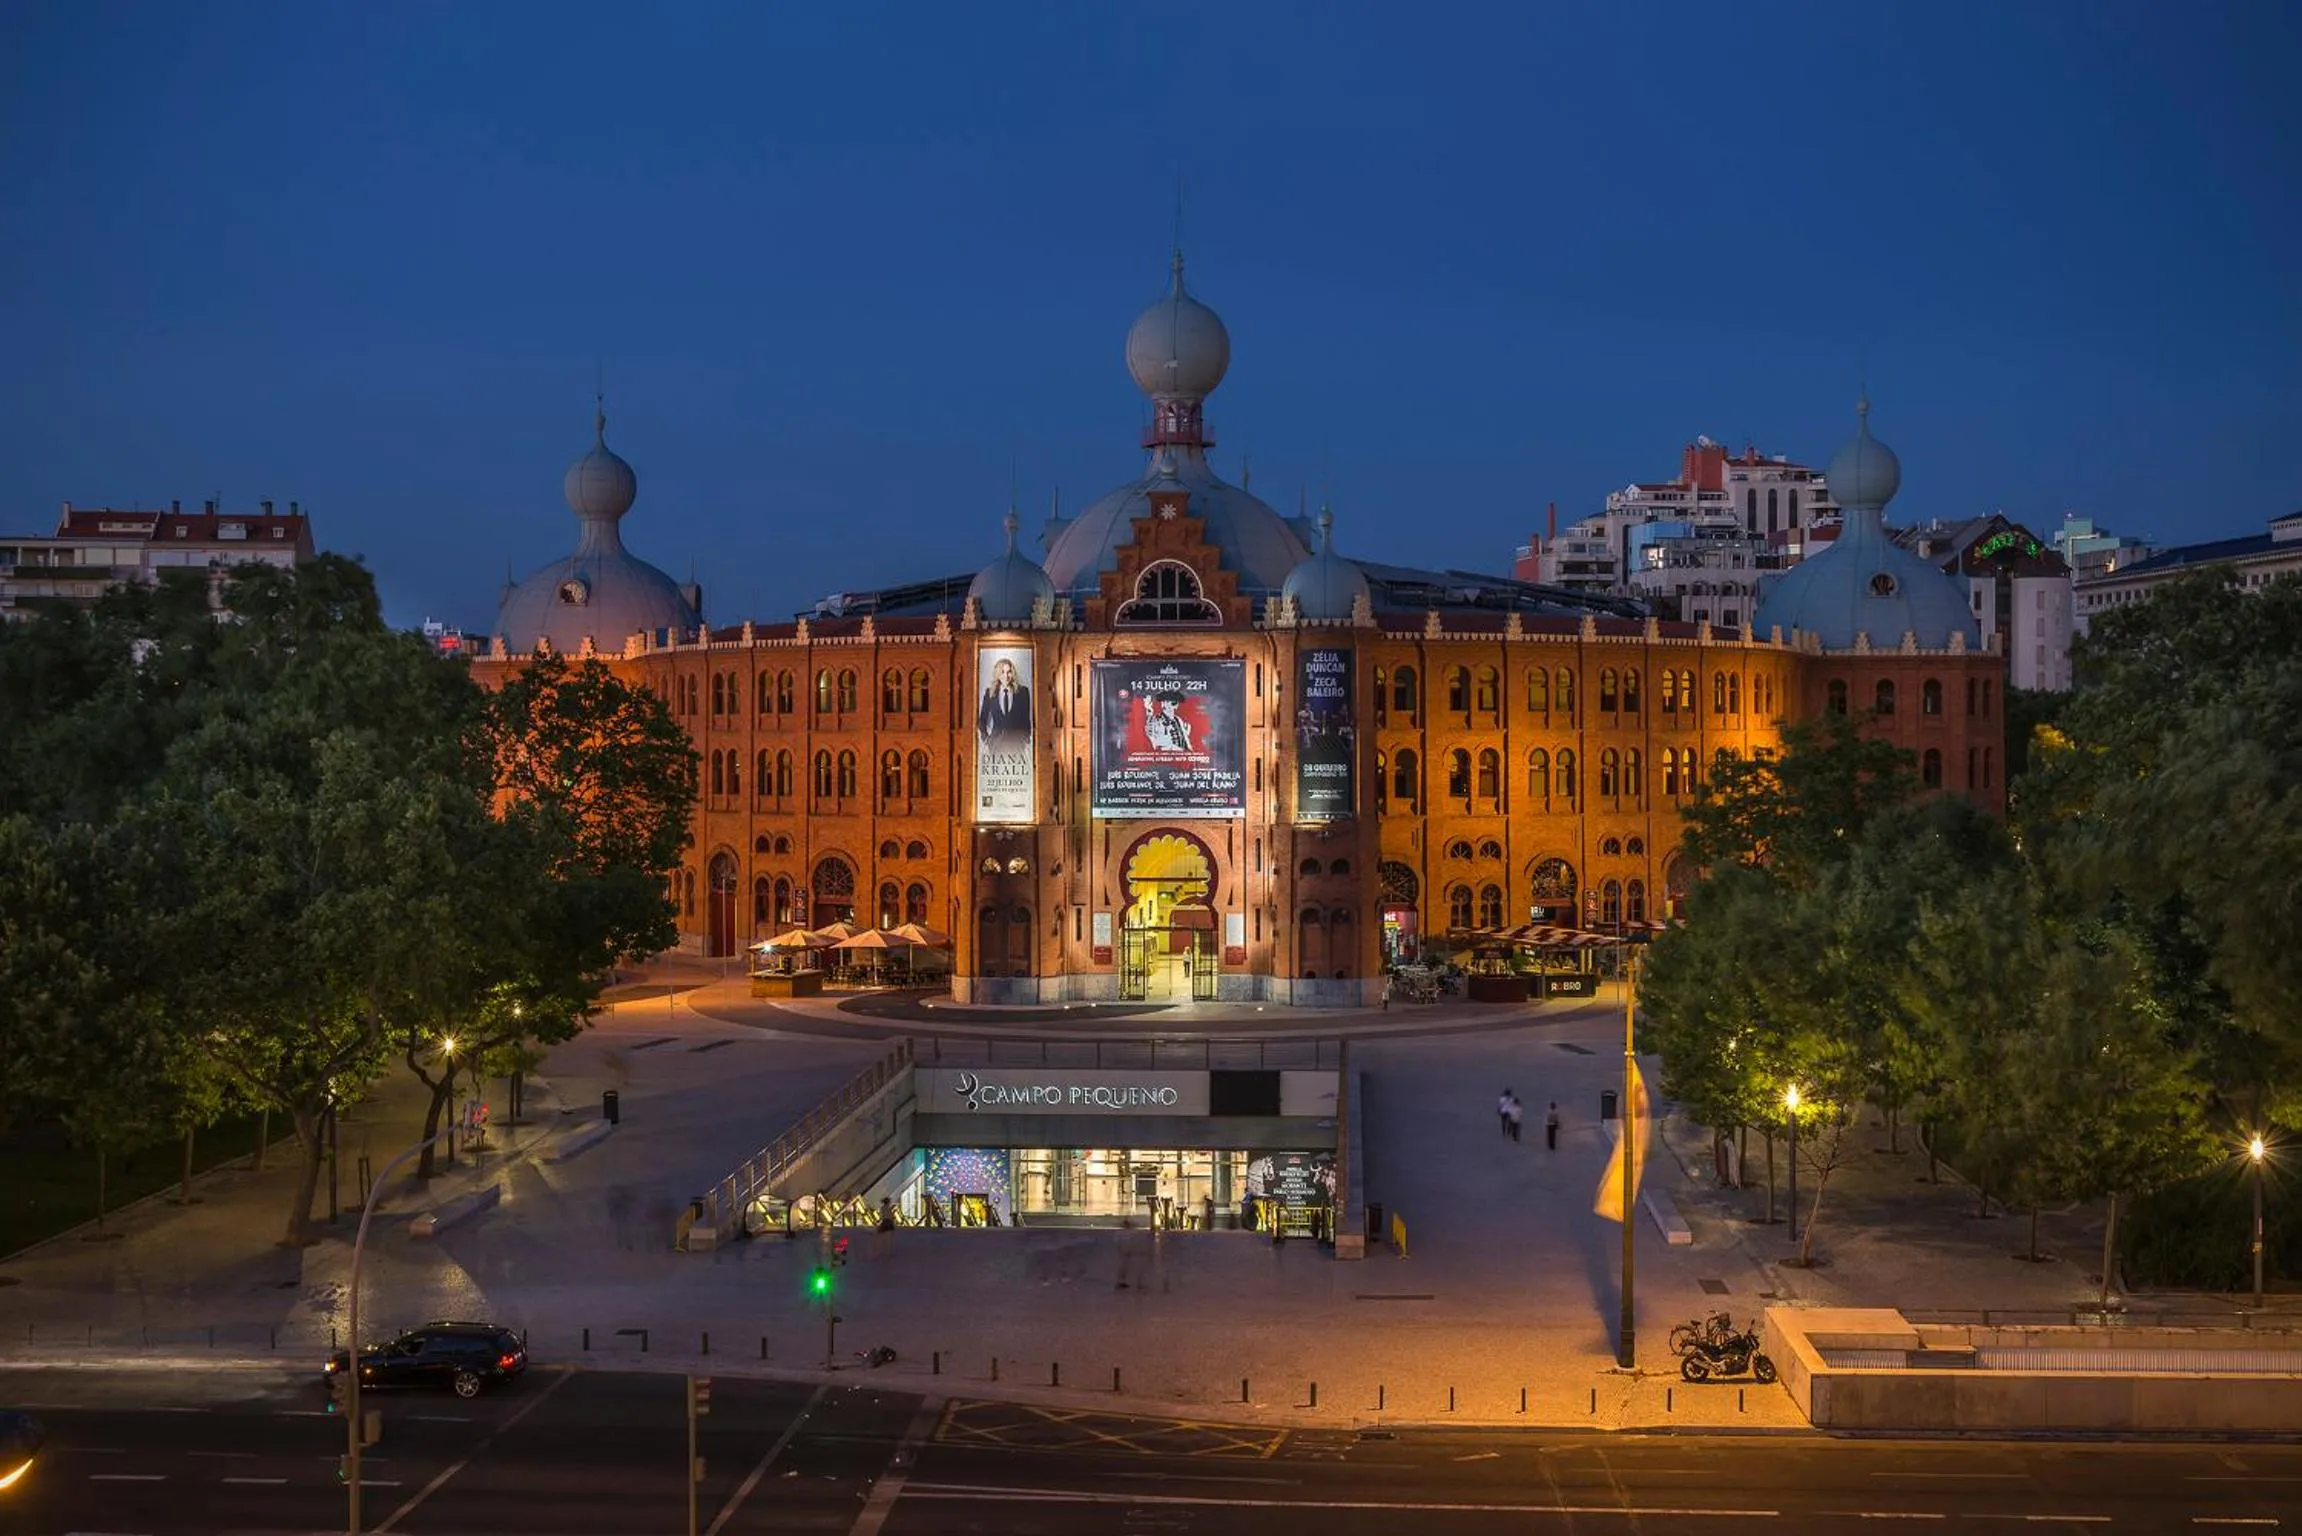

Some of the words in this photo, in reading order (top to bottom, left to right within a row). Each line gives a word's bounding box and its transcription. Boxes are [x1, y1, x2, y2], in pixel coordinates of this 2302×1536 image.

[1313, 651, 1339, 662] ZÉLIA
[1306, 662, 1345, 673] DUNCAN
[1130, 681, 1143, 690] 14
[1145, 681, 1181, 690] JULHO
[1186, 681, 1207, 690] 22H
[1314, 677, 1337, 687] ZECA
[1307, 687, 1345, 697] BALEIRO
[983, 754, 1026, 764] DIANA
[982, 765, 1029, 775] KRALL
[1169, 771, 1190, 780] JUAN
[1174, 781, 1195, 789] JUAN
[1551, 981, 1581, 991] ROBRO
[980, 1085, 1062, 1105] CAMPO
[1069, 1086, 1178, 1109] PEQUENO
